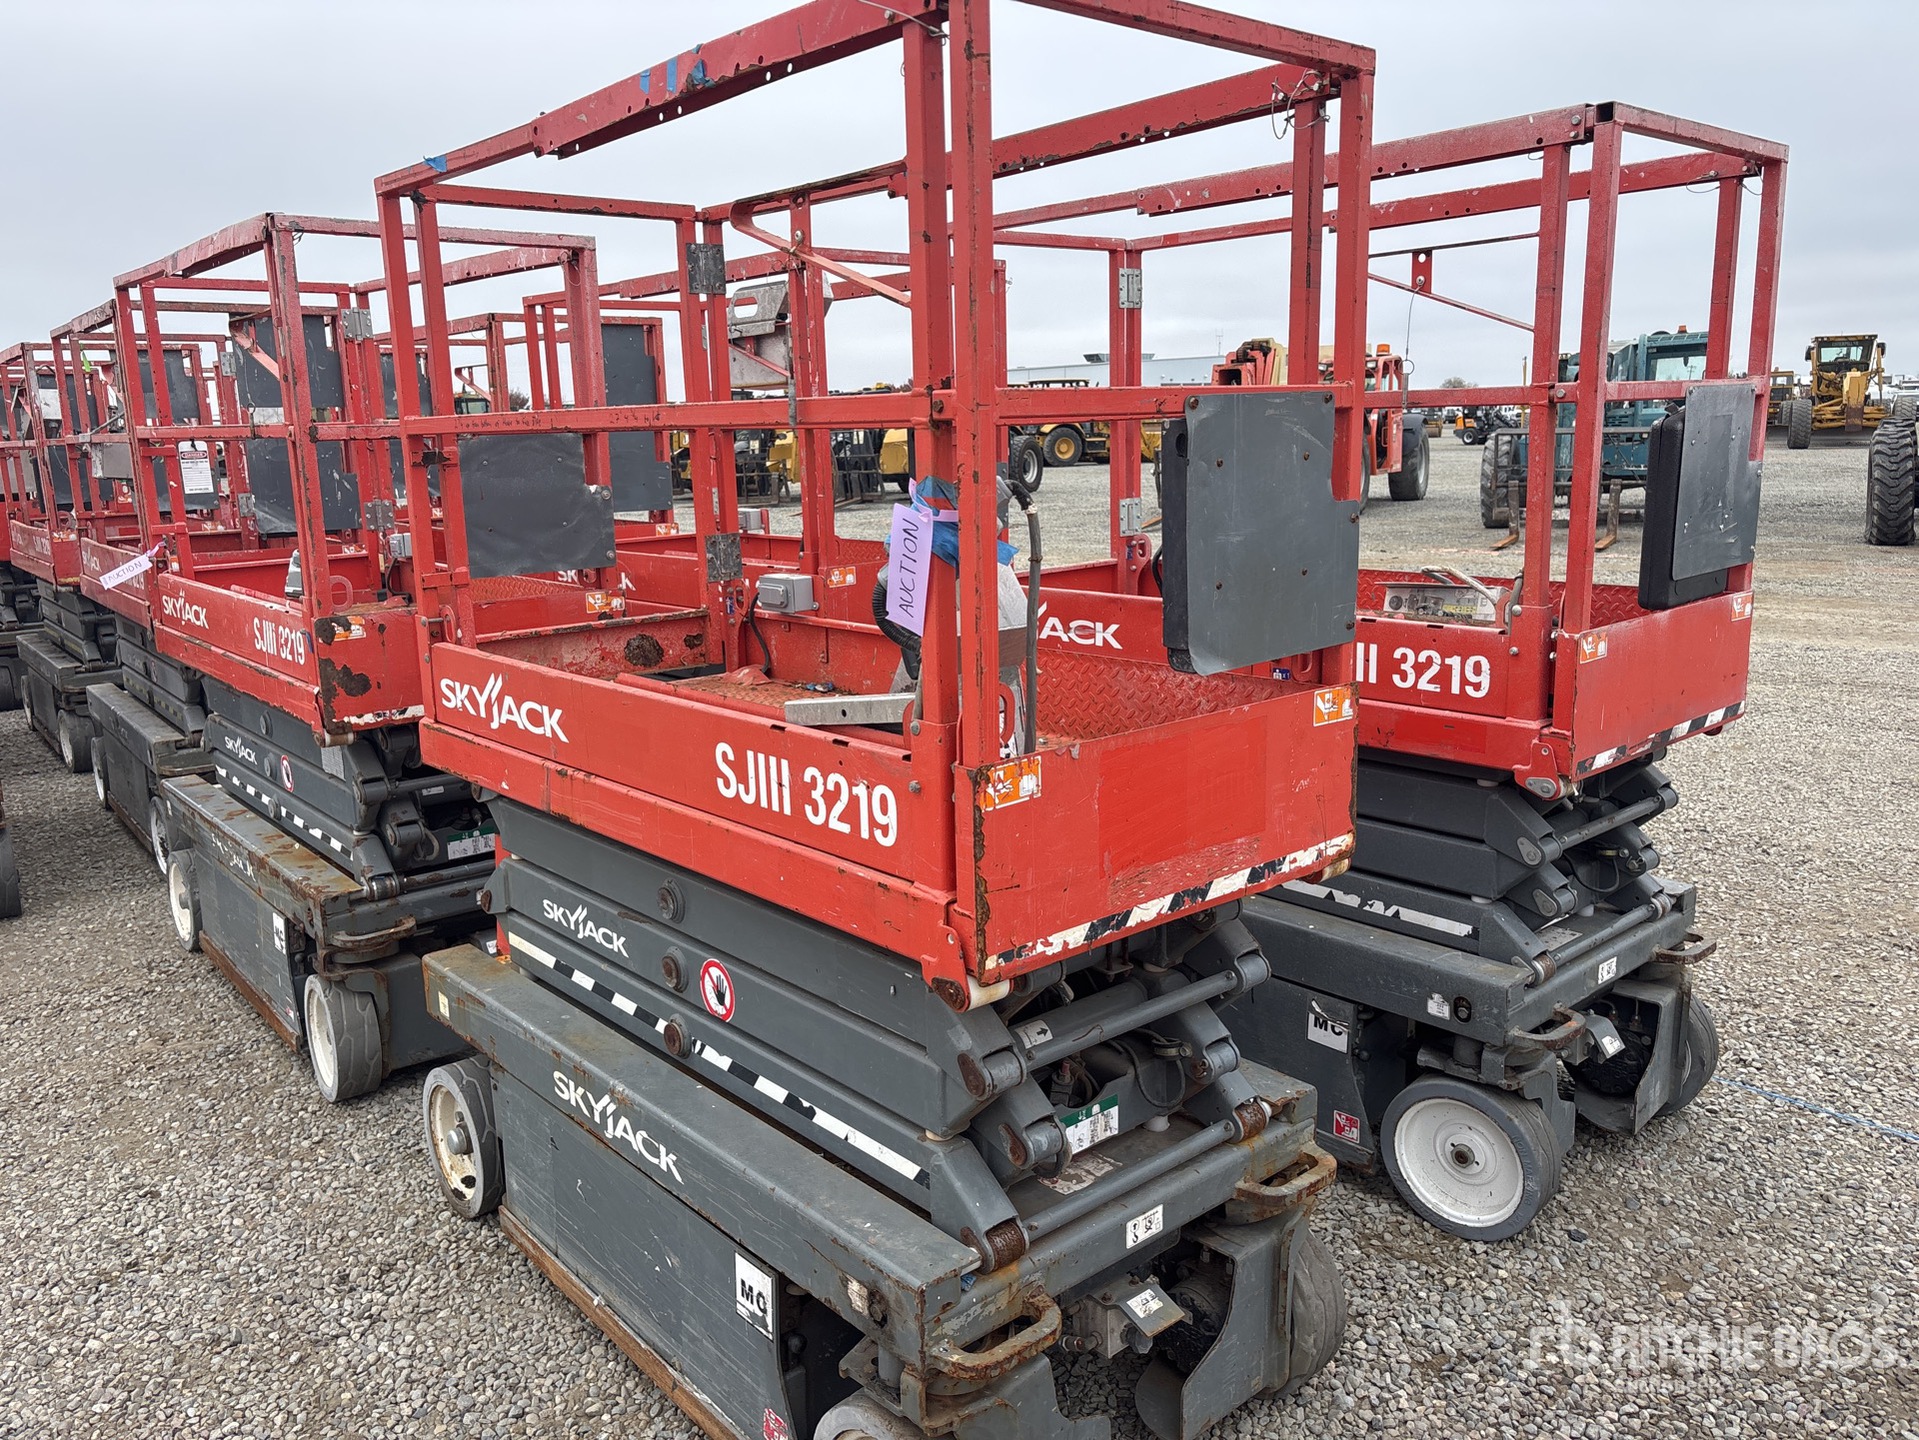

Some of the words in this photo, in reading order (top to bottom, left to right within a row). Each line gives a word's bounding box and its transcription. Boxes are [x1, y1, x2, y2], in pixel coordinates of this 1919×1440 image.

[108, 560, 142, 583] AUCTION
[899, 518, 919, 619] AUCTION
[162, 588, 210, 629] SKYJACK
[278, 625, 305, 666] 3219
[1392, 647, 1491, 698] 3219
[440, 672, 570, 743] SKYJACK
[225, 736, 258, 765] SKYJACK
[715, 742, 791, 816] SJIII
[803, 766, 898, 847] 3219
[542, 899, 630, 958] SKYJACK
[1313, 1015, 1343, 1036] MC
[553, 1070, 685, 1185] SKYJACK
